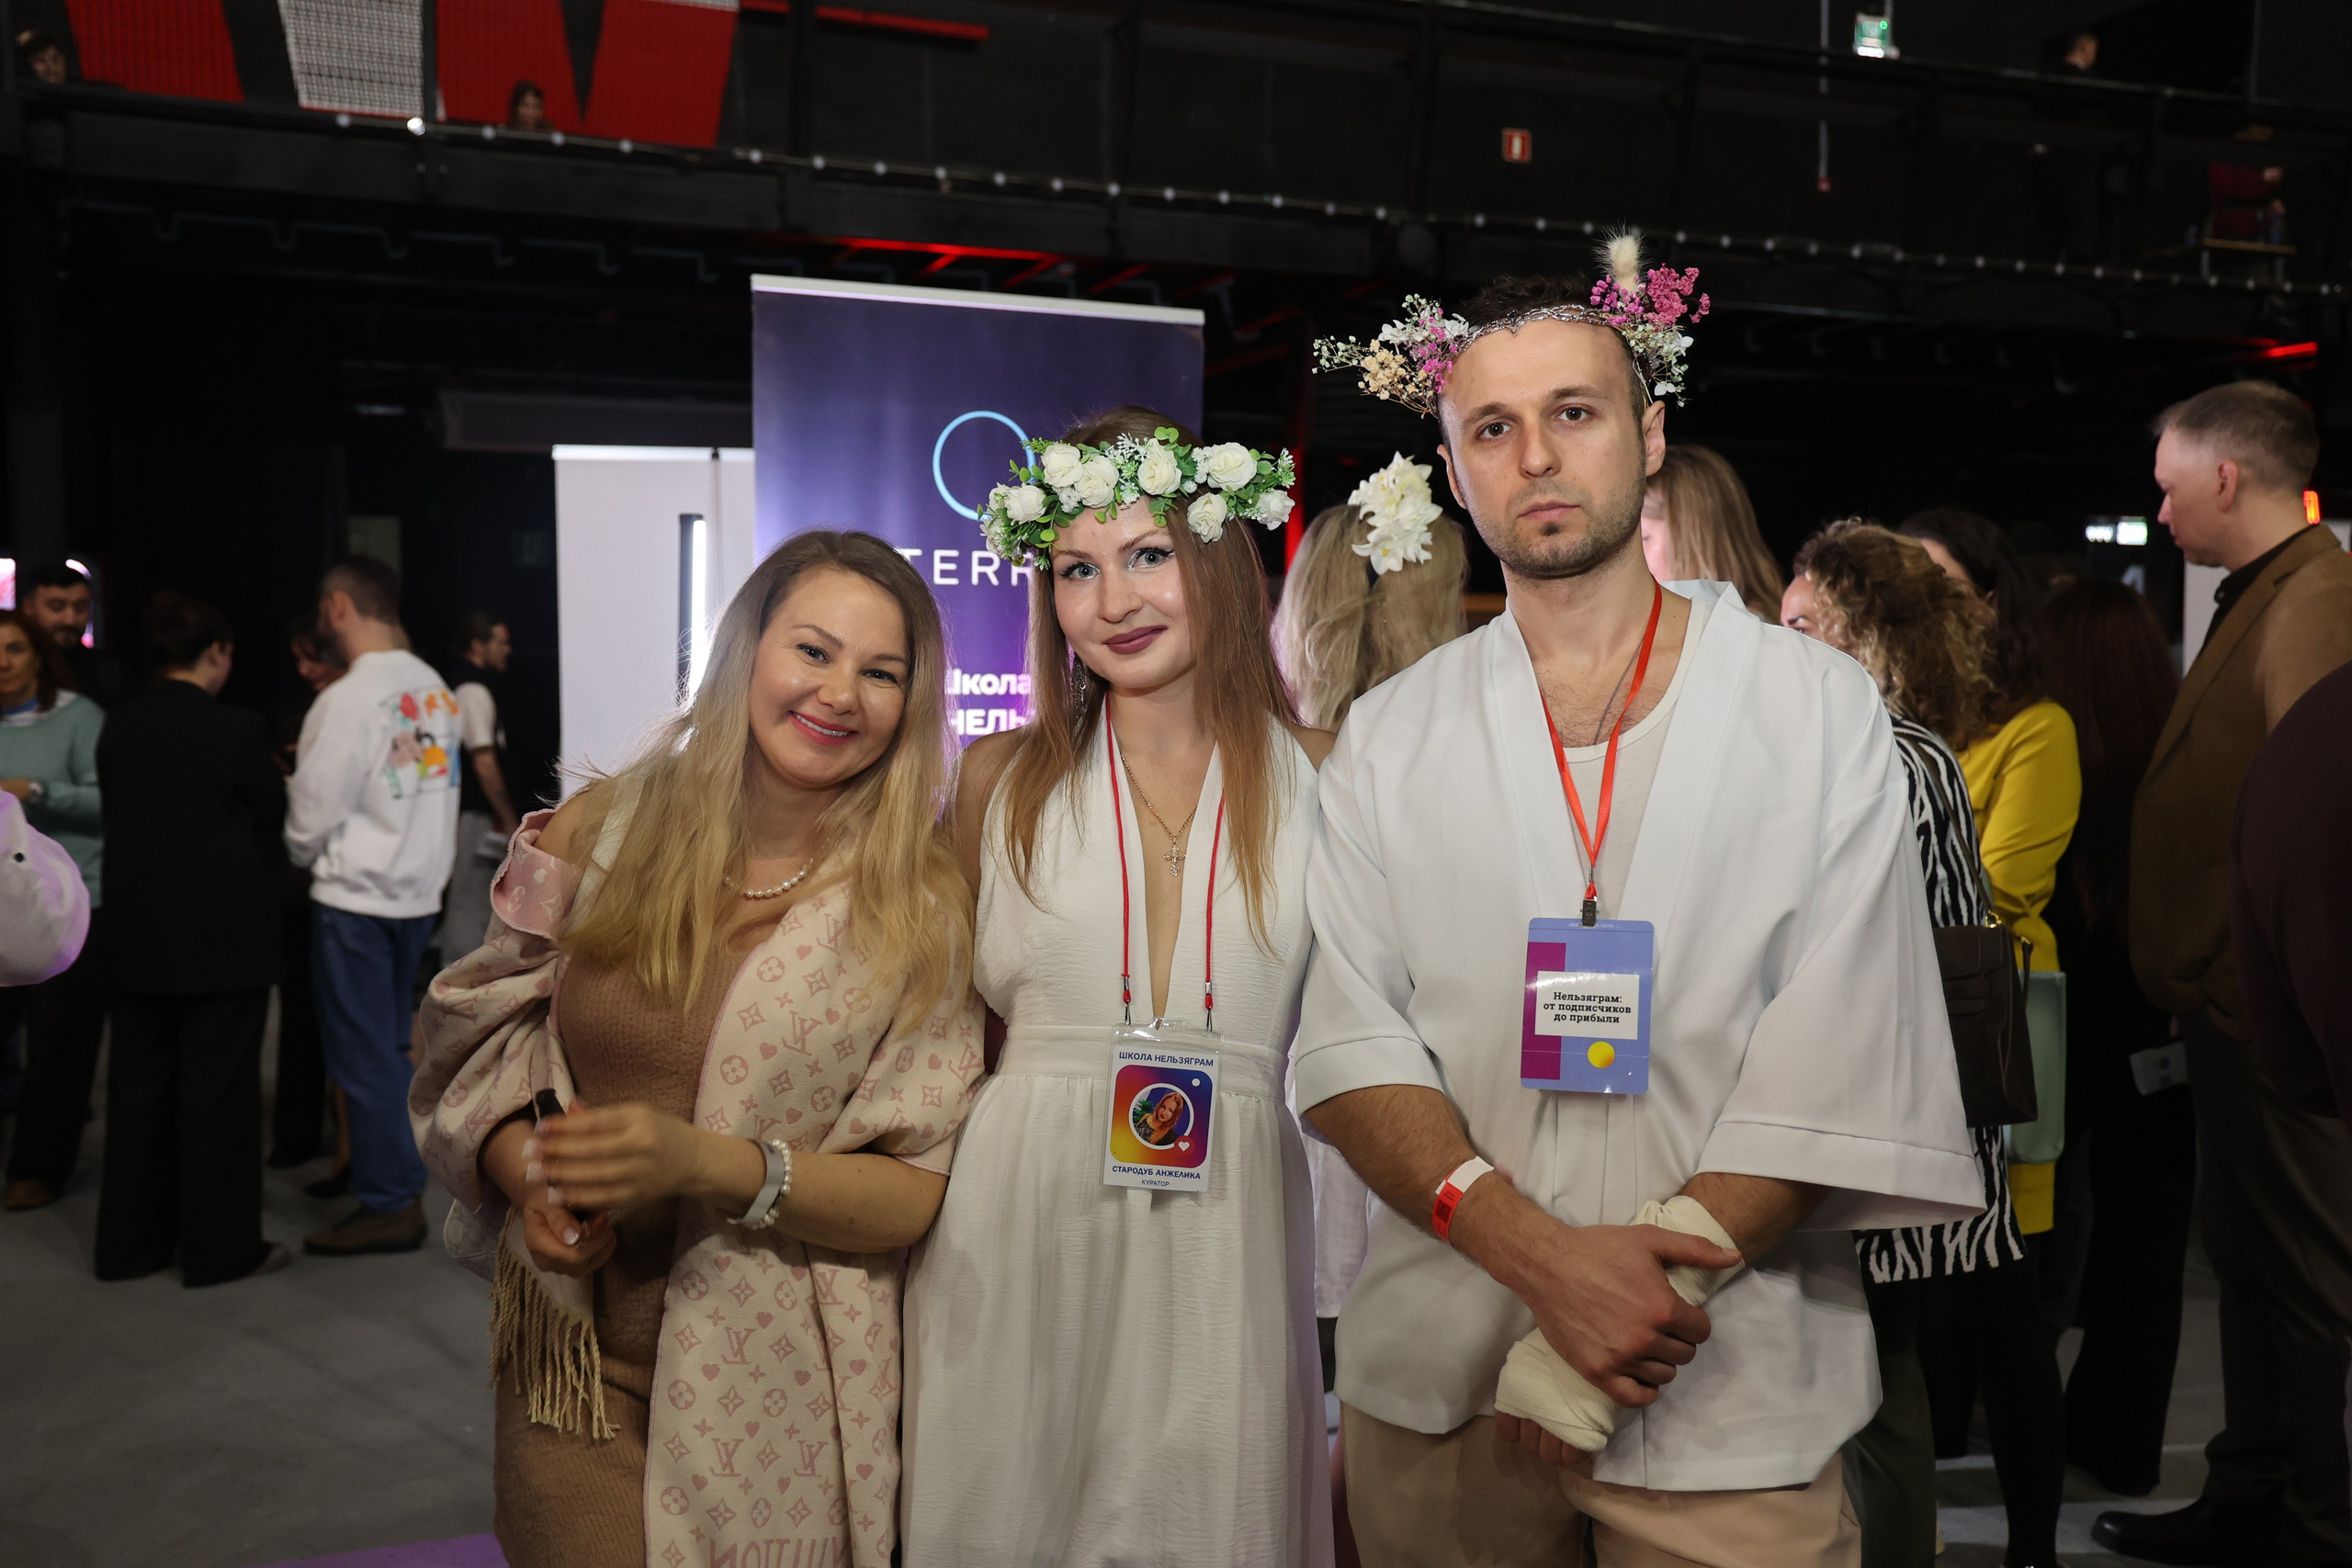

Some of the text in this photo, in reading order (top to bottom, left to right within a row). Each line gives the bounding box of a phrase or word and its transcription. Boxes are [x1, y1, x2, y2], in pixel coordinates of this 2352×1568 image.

[1553, 991, 1623, 1004] Нельзяграм:
[1558, 1003, 1632, 1014] подписчиков
[1553, 1013, 1620, 1024] до прибыли
[1118, 1051, 1214, 1066] ШКОЛА НЕЛЬЗЯГРАМ
[1112, 1165, 1201, 1179] СТАРОДУБ АНЖЕЛИКА
[1141, 1179, 1170, 1187] КУРАТОР
